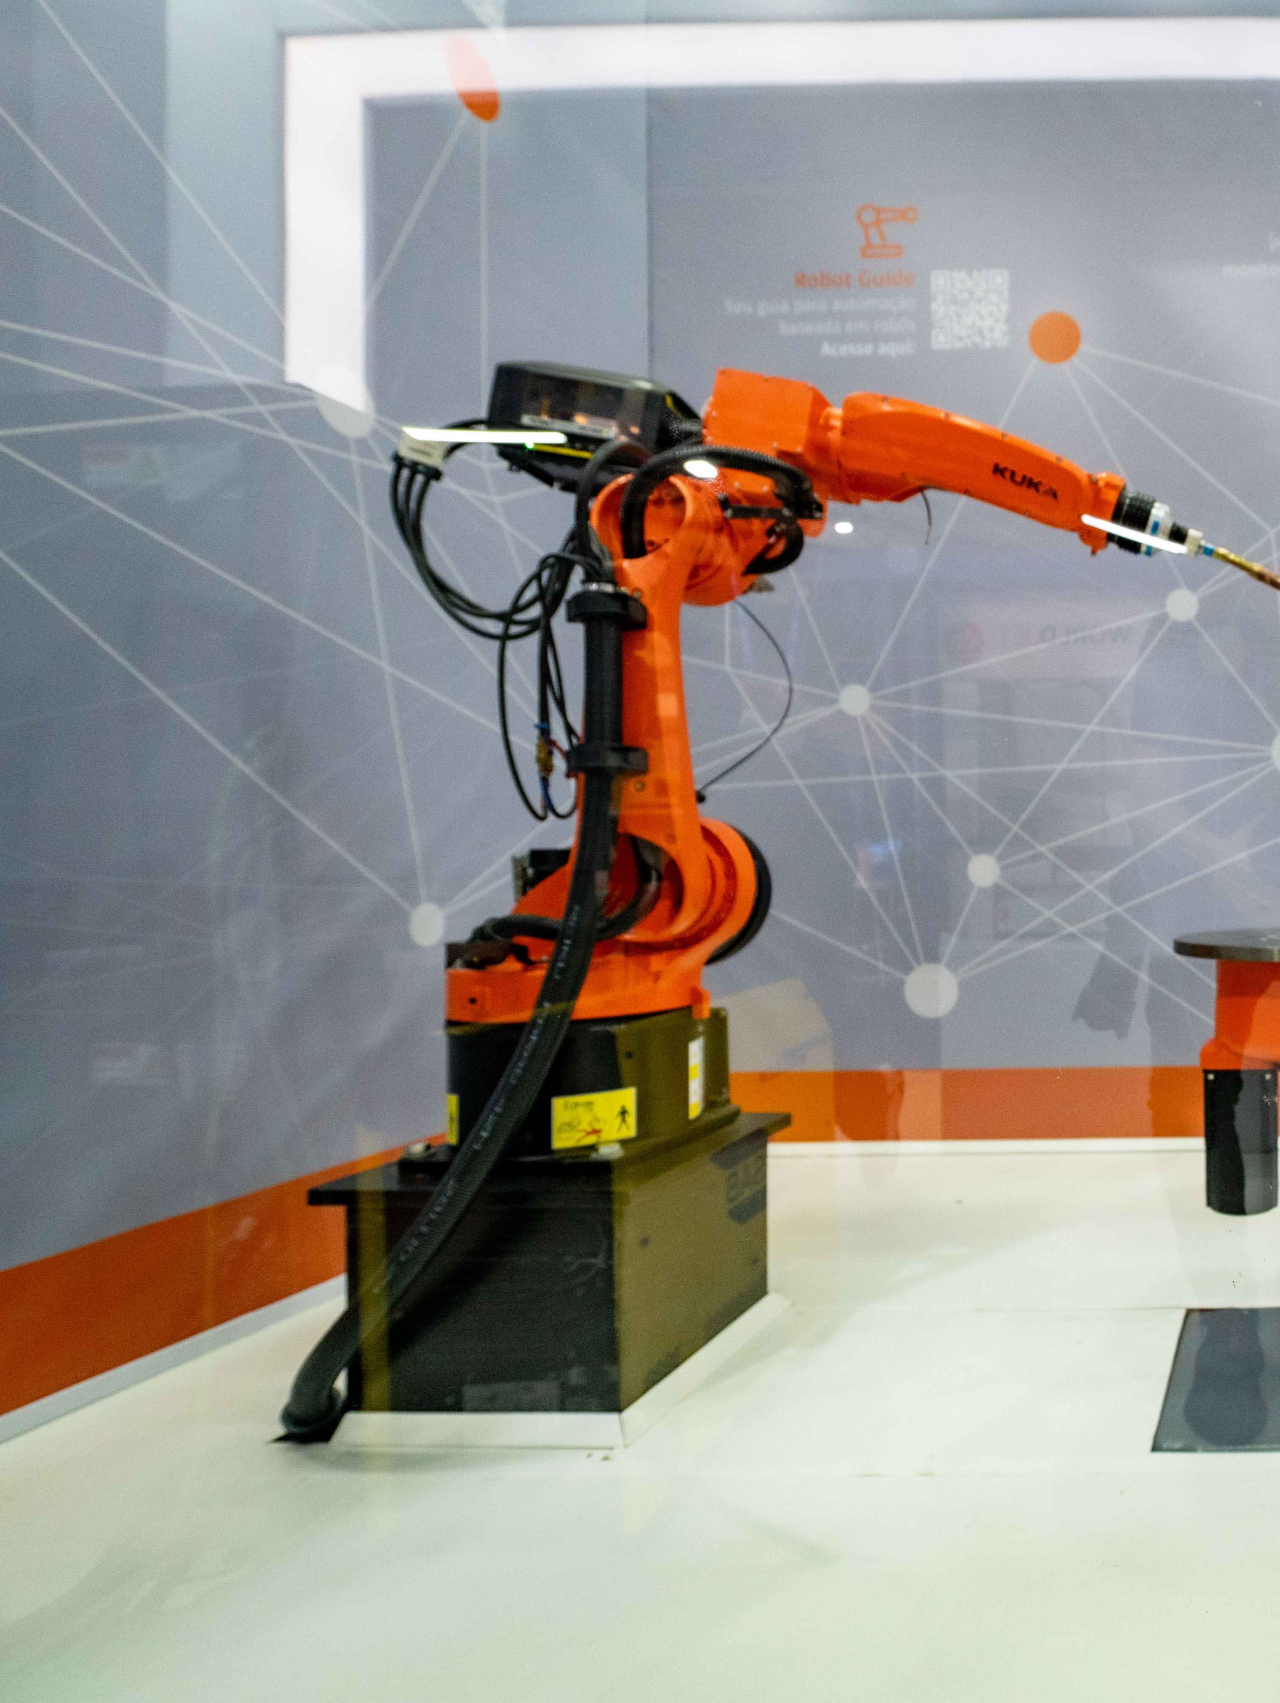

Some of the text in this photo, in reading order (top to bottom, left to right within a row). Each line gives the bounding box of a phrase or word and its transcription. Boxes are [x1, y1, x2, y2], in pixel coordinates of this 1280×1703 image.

[794, 268, 915, 289] Robot Guide
[820, 341, 873, 357] Acesse
[992, 462, 1058, 500] KUKA
